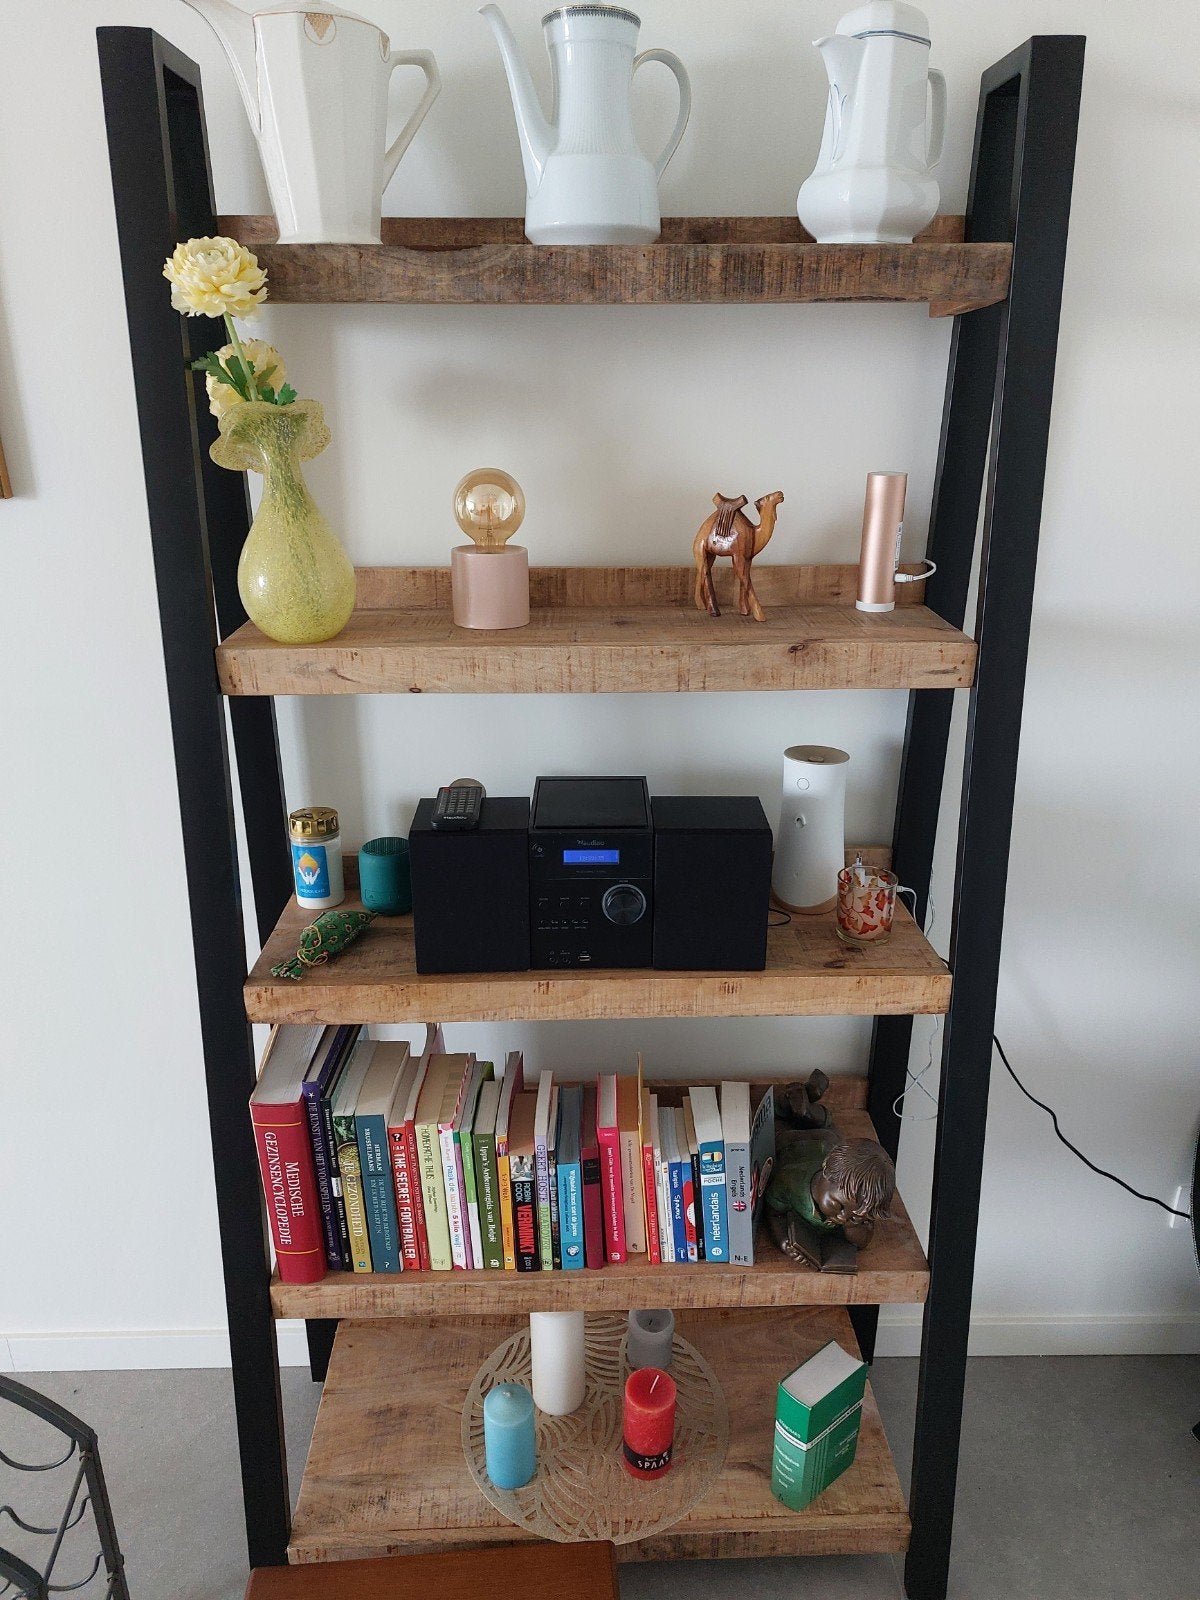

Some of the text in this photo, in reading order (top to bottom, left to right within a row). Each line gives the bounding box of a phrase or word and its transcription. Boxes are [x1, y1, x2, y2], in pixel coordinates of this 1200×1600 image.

[308, 1102, 318, 1112] DE
[310, 1113, 320, 1136] KUNST
[312, 1138, 323, 1153] VAN
[315, 1153, 325, 1166] HET
[364, 1128, 374, 1172] BRUSSELMANS
[374, 1144, 382, 1172] HERMAN
[393, 1152, 406, 1169] THE
[480, 1146, 491, 1166] Ippa's
[264, 1132, 292, 1245] GEZINSENCYCLOPEDIE
[284, 1161, 304, 1218] MEDISCHE
[316, 1167, 332, 1214] VOORSPELLEN
[346, 1174, 363, 1237] GEZONDHEID
[396, 1172, 410, 1204] SECRET
[482, 1167, 495, 1210] Ardennengids
[515, 1183, 523, 1202] COOK
[536, 1144, 550, 1251] GEERT HOSTE DAAROVER
[400, 1207, 416, 1259] FOOTBALLER
[517, 1204, 534, 1254] VERMINKT
[710, 1192, 720, 1240] néerlandais
[383, 1222, 392, 1251] BEROEMD
